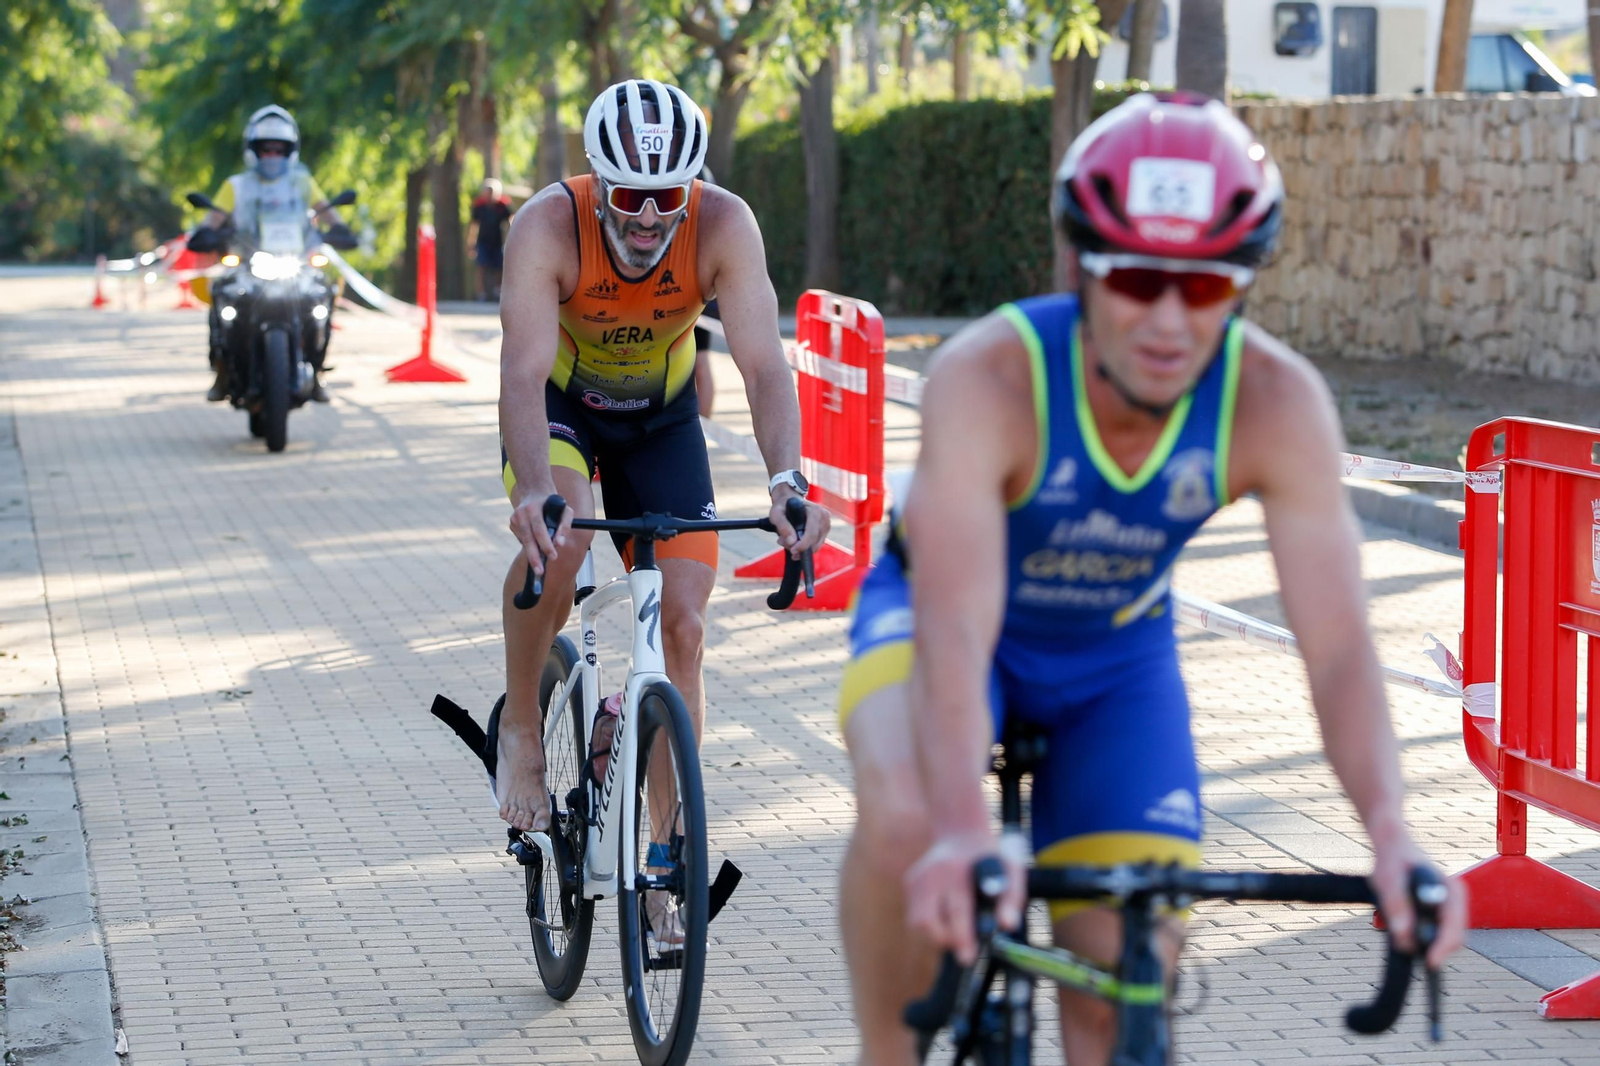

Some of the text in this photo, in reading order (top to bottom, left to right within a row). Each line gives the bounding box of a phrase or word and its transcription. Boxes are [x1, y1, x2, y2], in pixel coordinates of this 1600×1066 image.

[641, 136, 663, 152] 50
[601, 326, 654, 345] VERA
[582, 390, 650, 411] Ceballos
